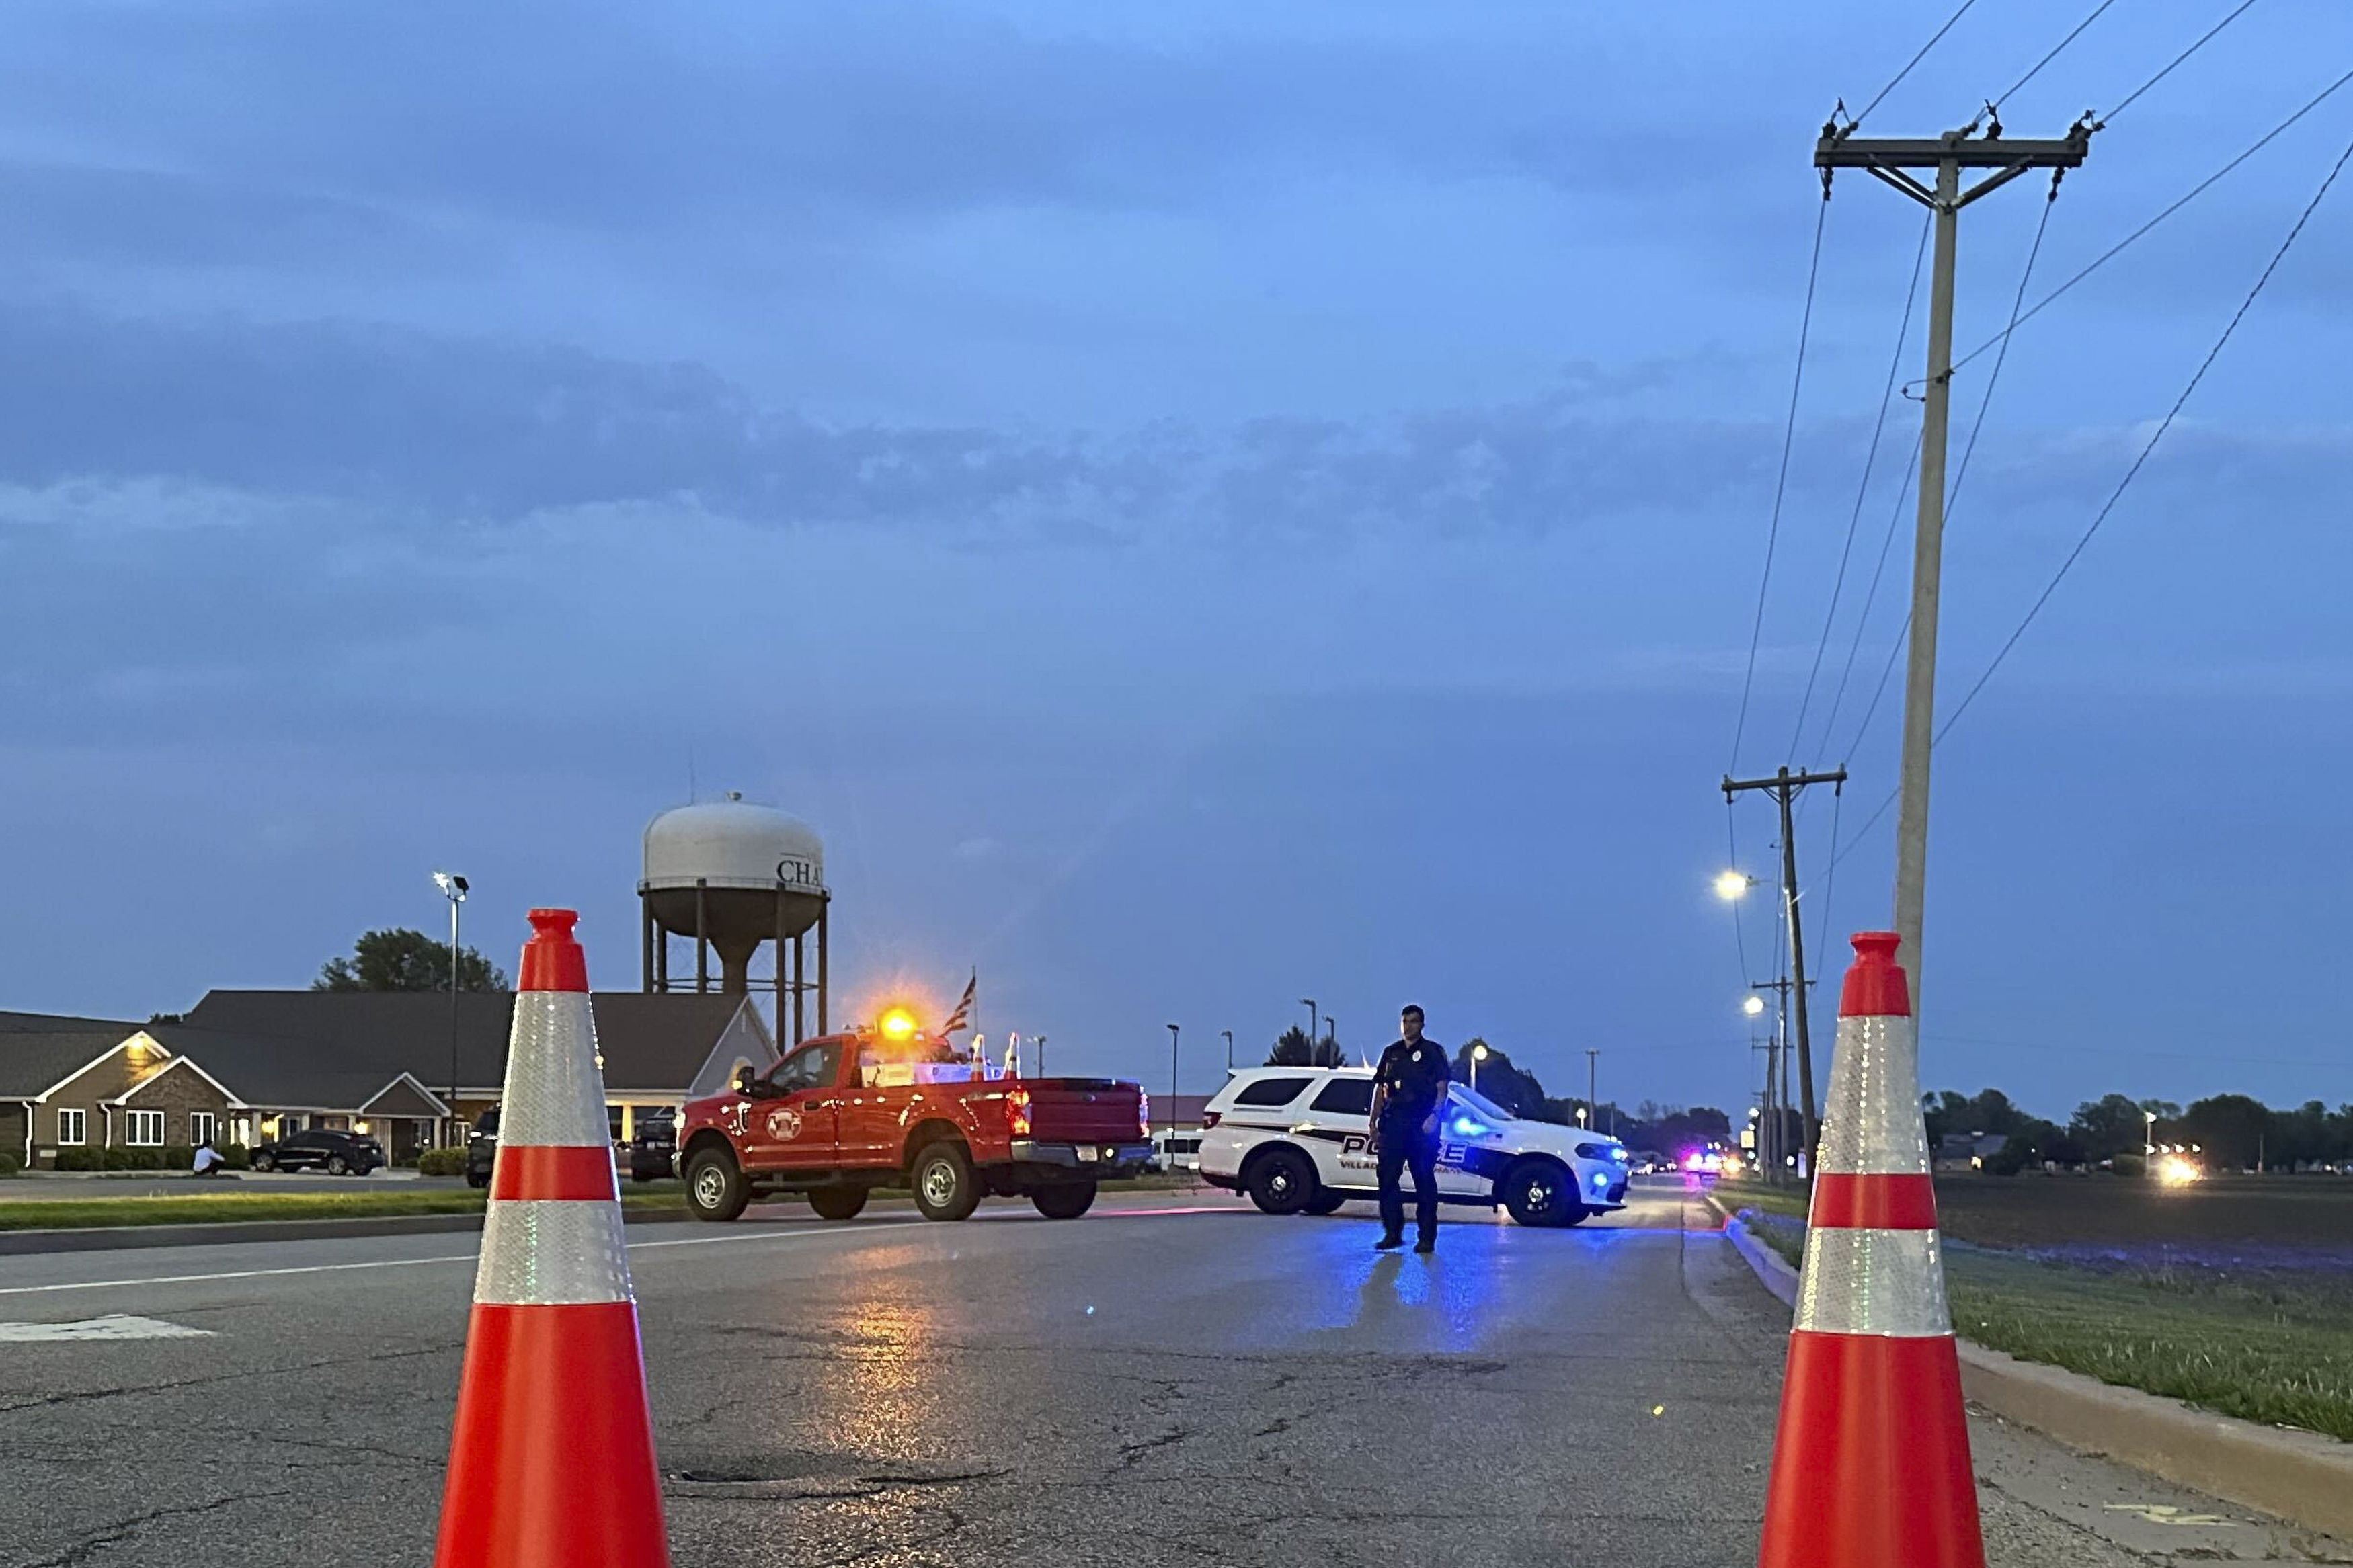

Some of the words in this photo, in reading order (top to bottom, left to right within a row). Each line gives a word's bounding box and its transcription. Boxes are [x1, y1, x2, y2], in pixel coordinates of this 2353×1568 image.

[777, 860, 822, 886] CHA
[1343, 1136, 1467, 1163] POE
[1341, 1161, 1379, 1170] VILLAG
